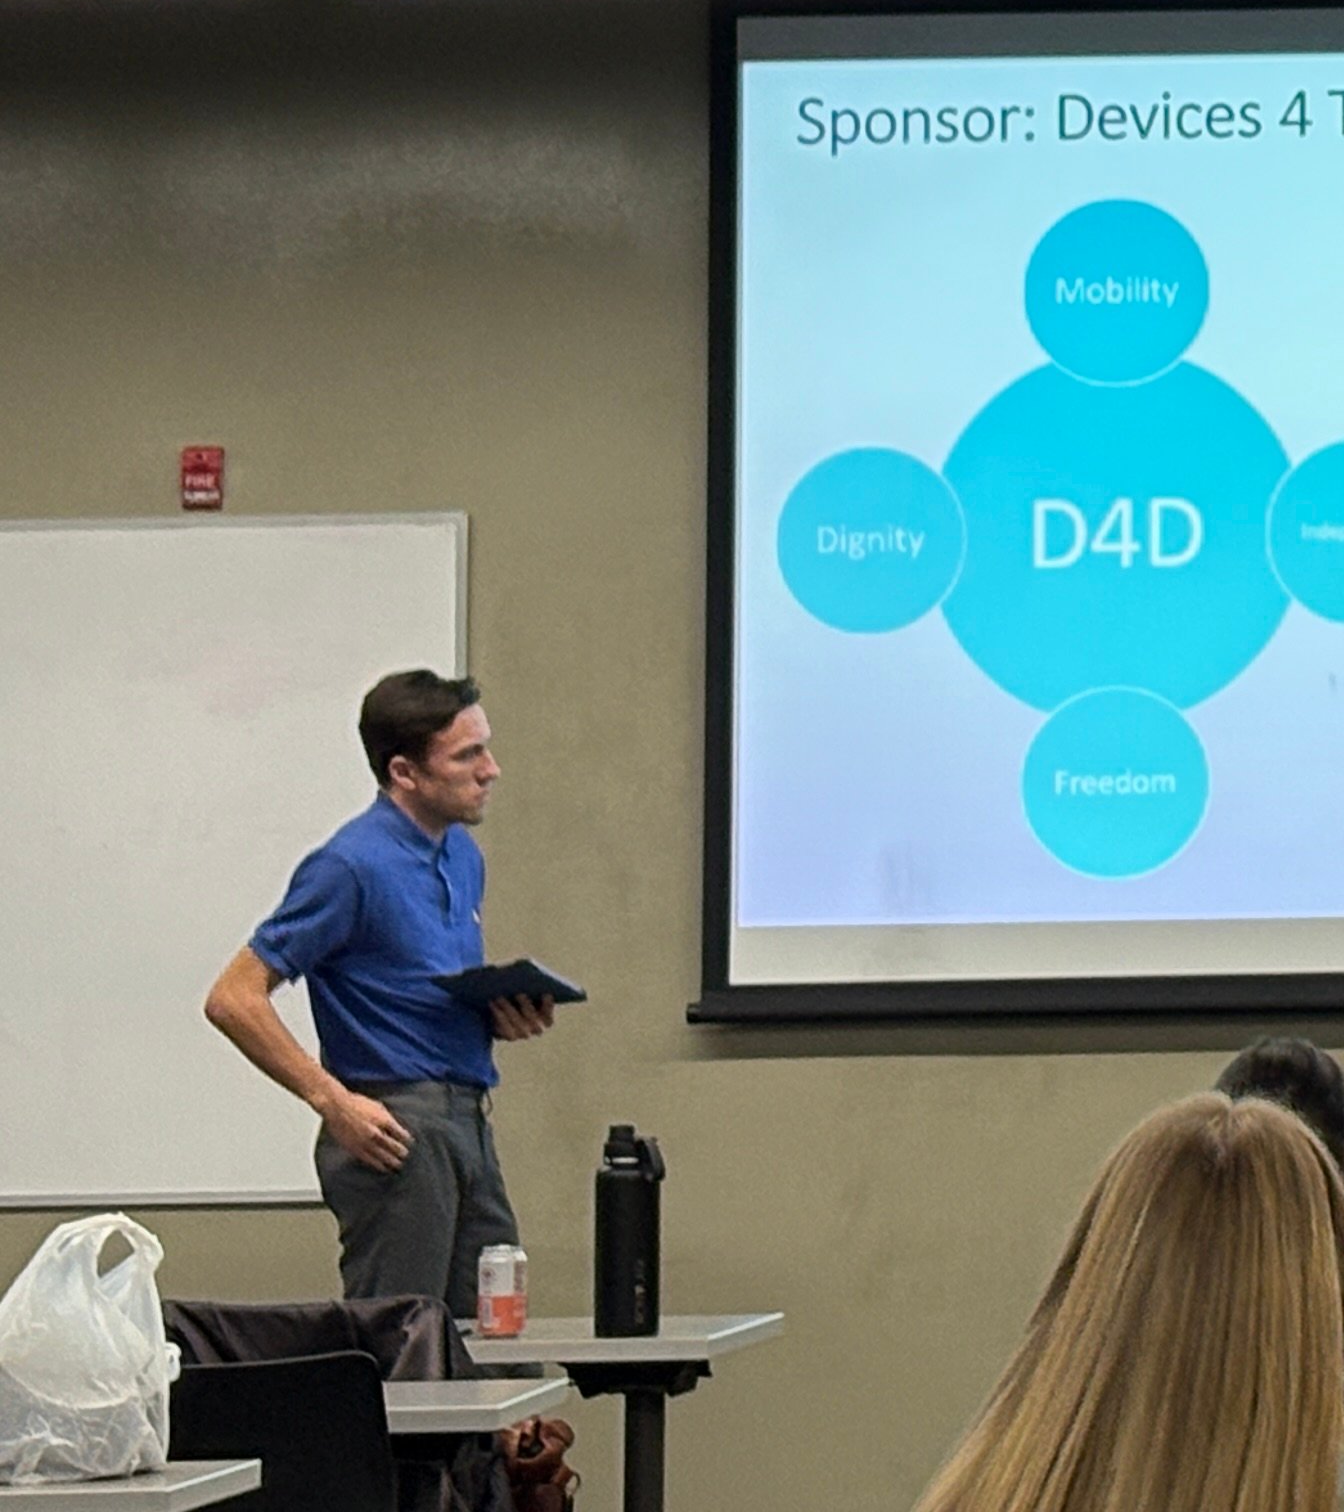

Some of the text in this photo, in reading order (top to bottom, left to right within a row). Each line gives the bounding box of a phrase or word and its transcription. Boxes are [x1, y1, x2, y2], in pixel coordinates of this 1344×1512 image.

[796, 97, 1035, 158] Sponsor:
[1057, 90, 1263, 141] Devices
[1278, 89, 1314, 138] 4
[1055, 276, 1180, 308] Mobility
[816, 525, 925, 560] Dignity
[1032, 498, 1201, 569] D4D
[1054, 769, 1176, 796] Freedom
